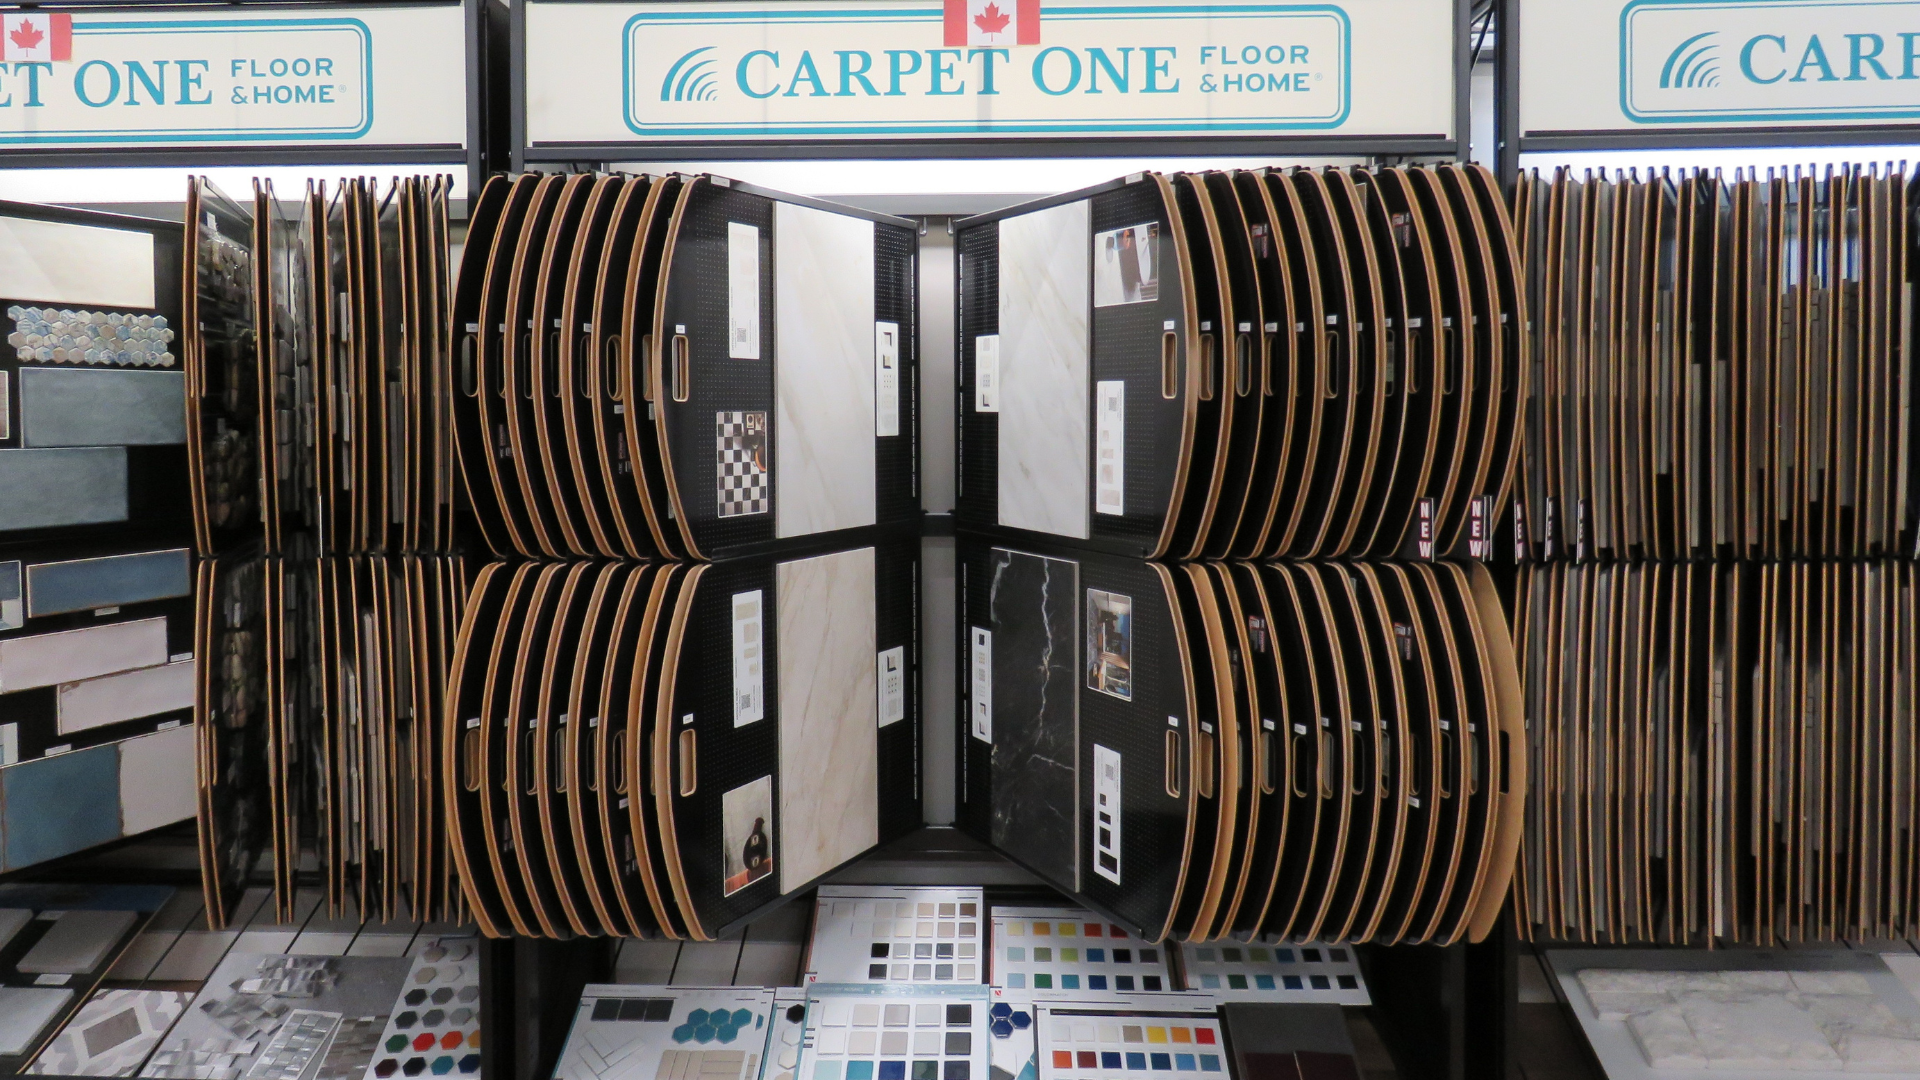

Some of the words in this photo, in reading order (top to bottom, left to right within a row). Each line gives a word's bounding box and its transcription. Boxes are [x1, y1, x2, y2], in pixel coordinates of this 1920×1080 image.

[231, 57, 333, 77] FLOOR
[735, 48, 1010, 99] CARPET
[1032, 46, 1180, 96] ONE
[1200, 45, 1309, 65] FLOOR
[74, 59, 212, 108] ONE
[1418, 502, 1431, 558] NEW
[1469, 500, 1483, 557] NEW
